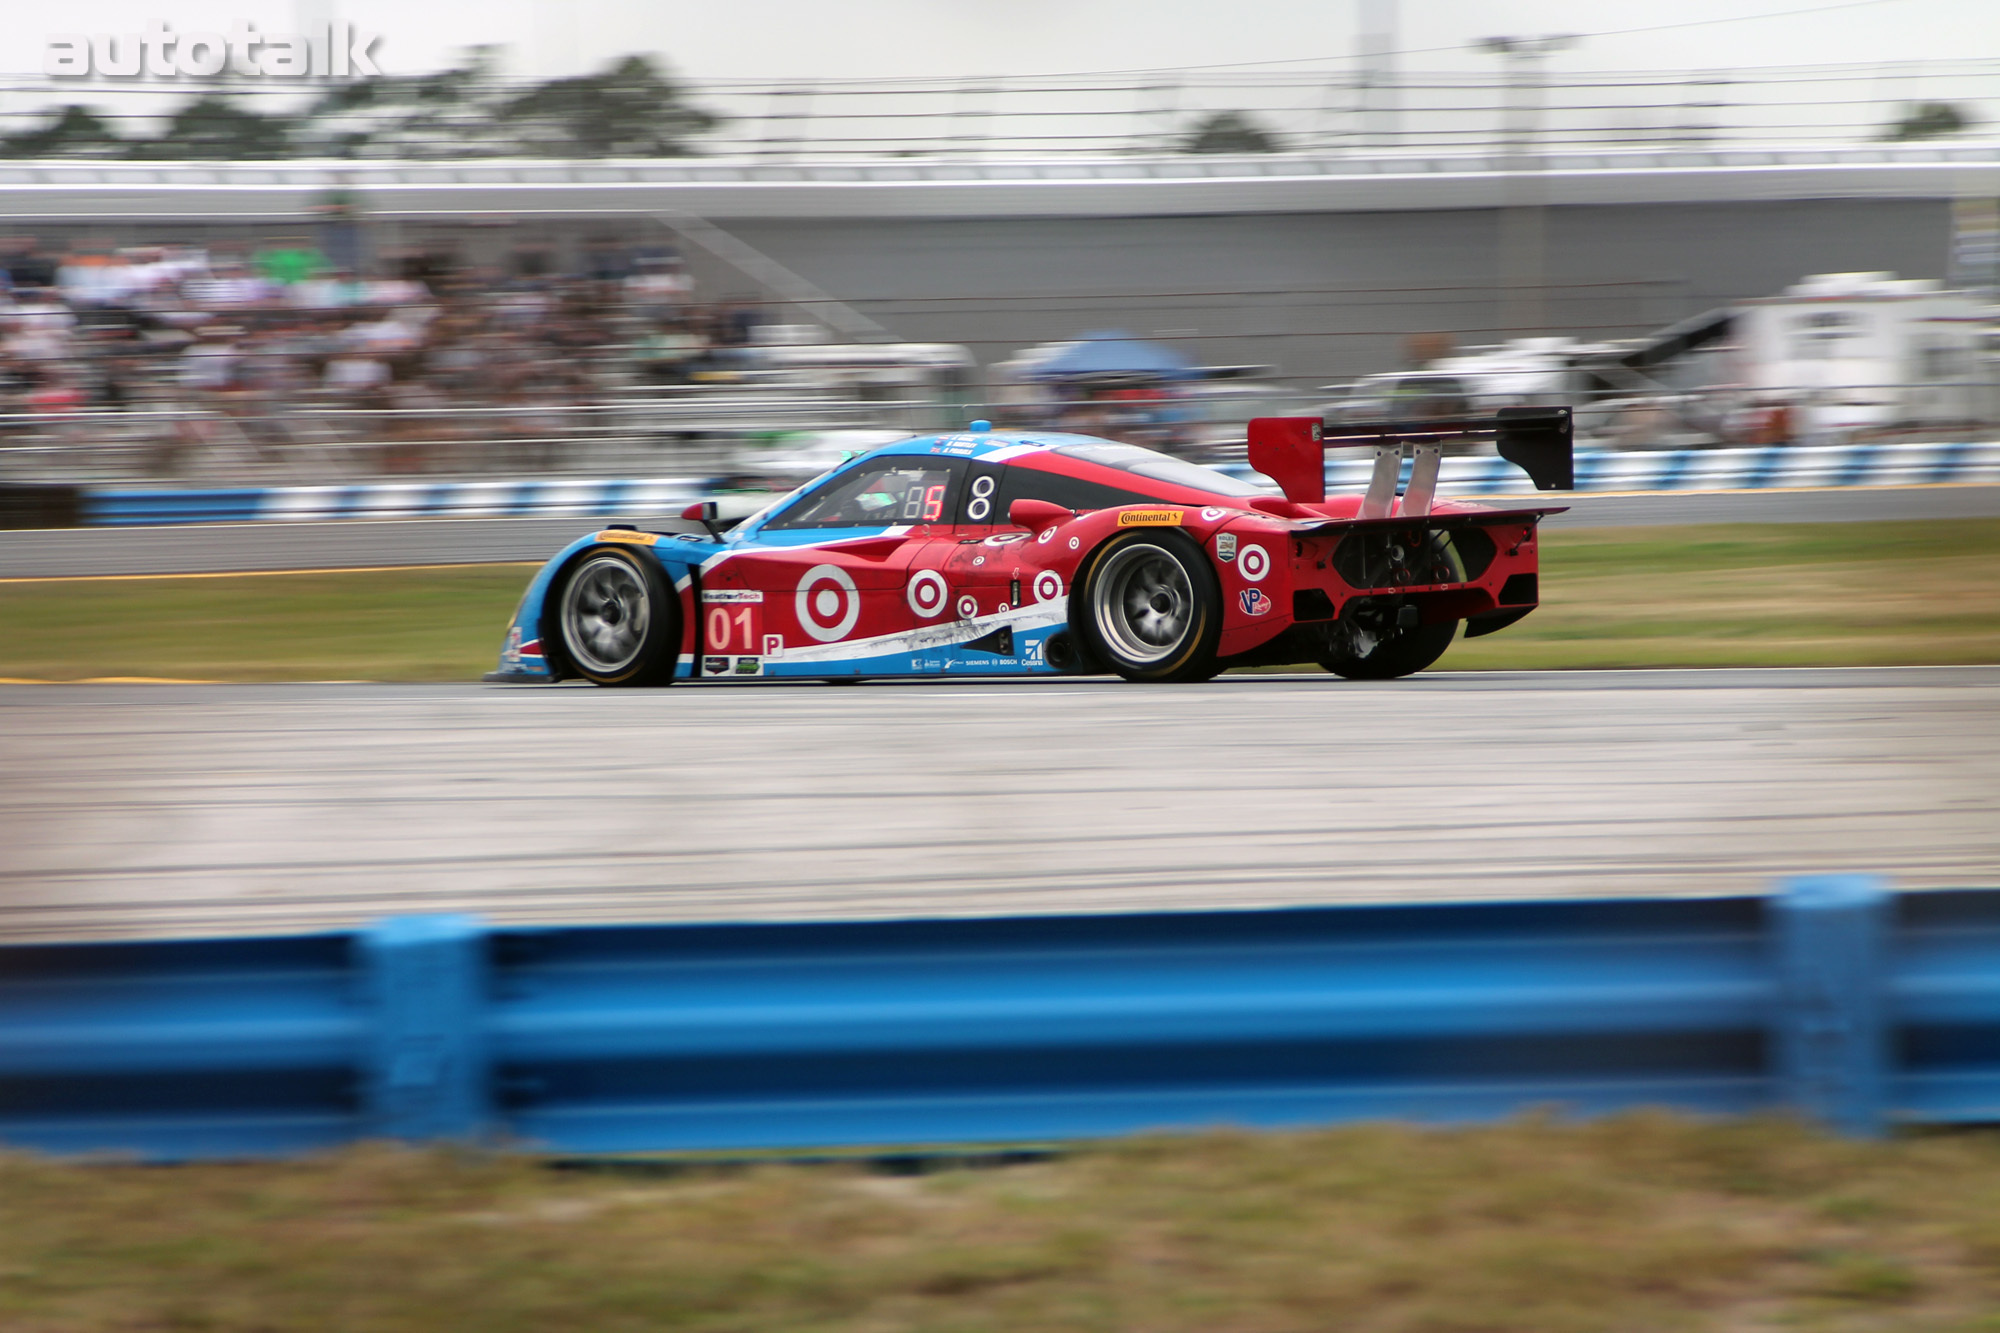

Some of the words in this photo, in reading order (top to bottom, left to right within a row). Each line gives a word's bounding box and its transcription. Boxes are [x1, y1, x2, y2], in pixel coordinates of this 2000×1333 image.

[1121, 512, 1170, 524] Continental
[1241, 589, 1261, 614] VP
[708, 607, 753, 650] 01
[767, 637, 780, 655] P
